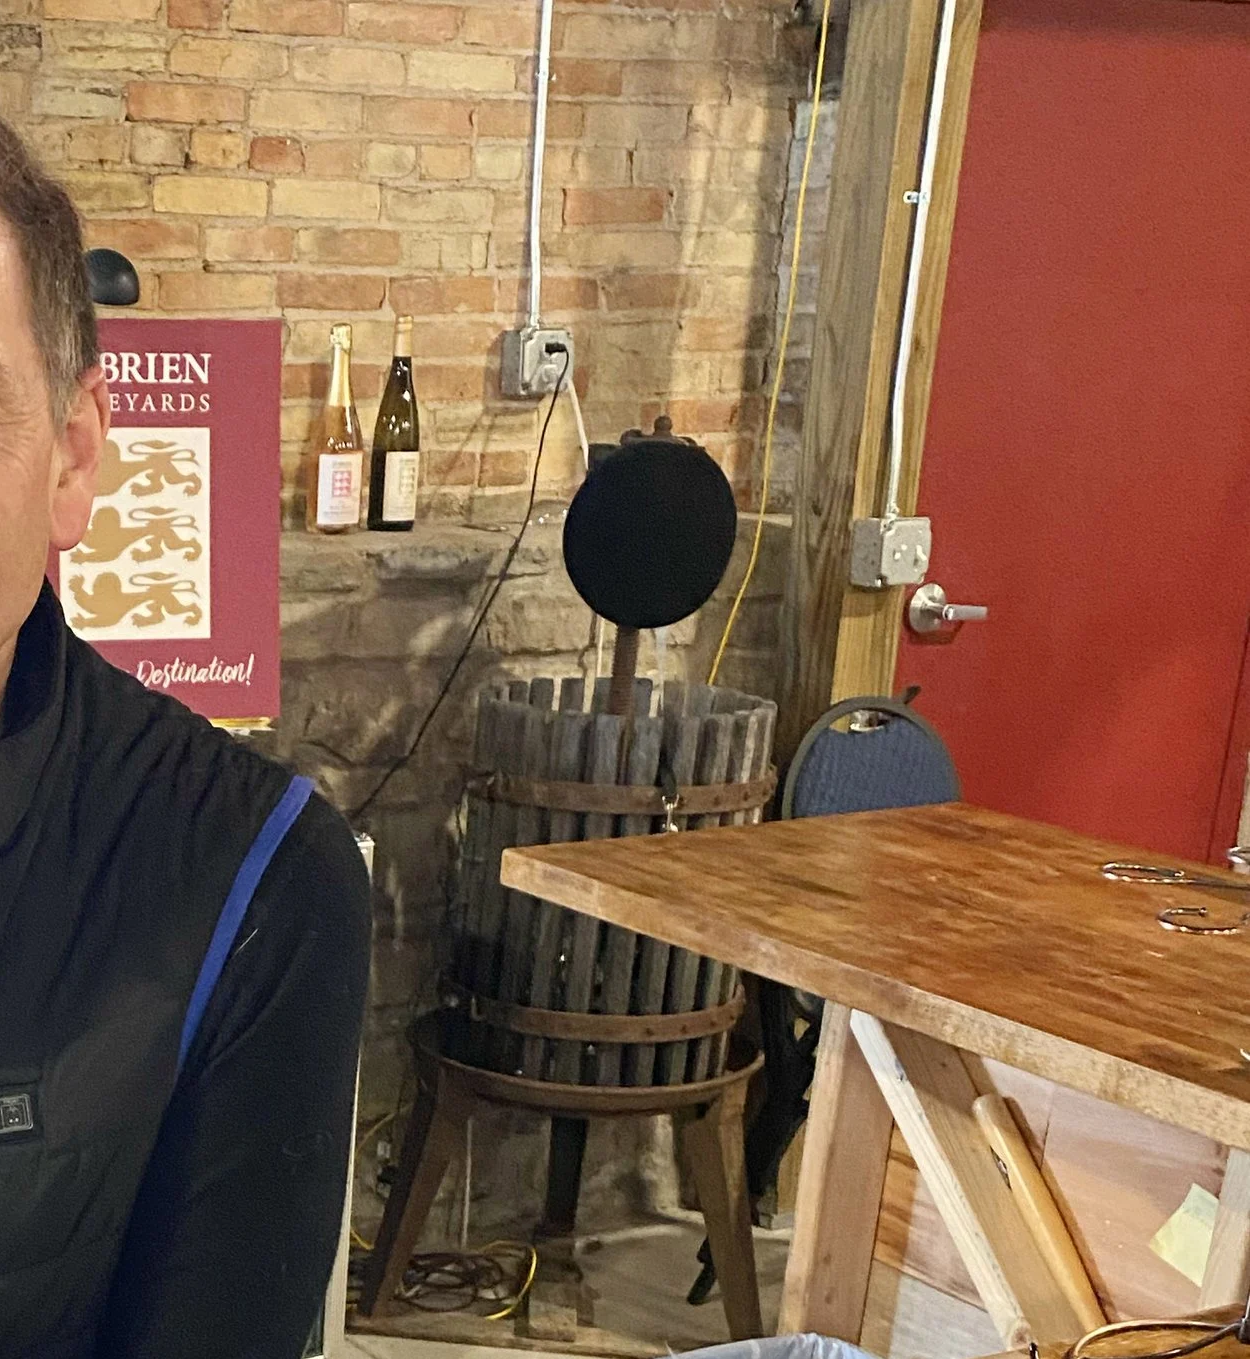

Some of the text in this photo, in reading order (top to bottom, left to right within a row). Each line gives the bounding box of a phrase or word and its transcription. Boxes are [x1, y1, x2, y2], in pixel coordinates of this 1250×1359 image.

[100, 352, 212, 384] BRIEN
[109, 393, 210, 412] EYARDS
[137, 653, 254, 688] Destination!
